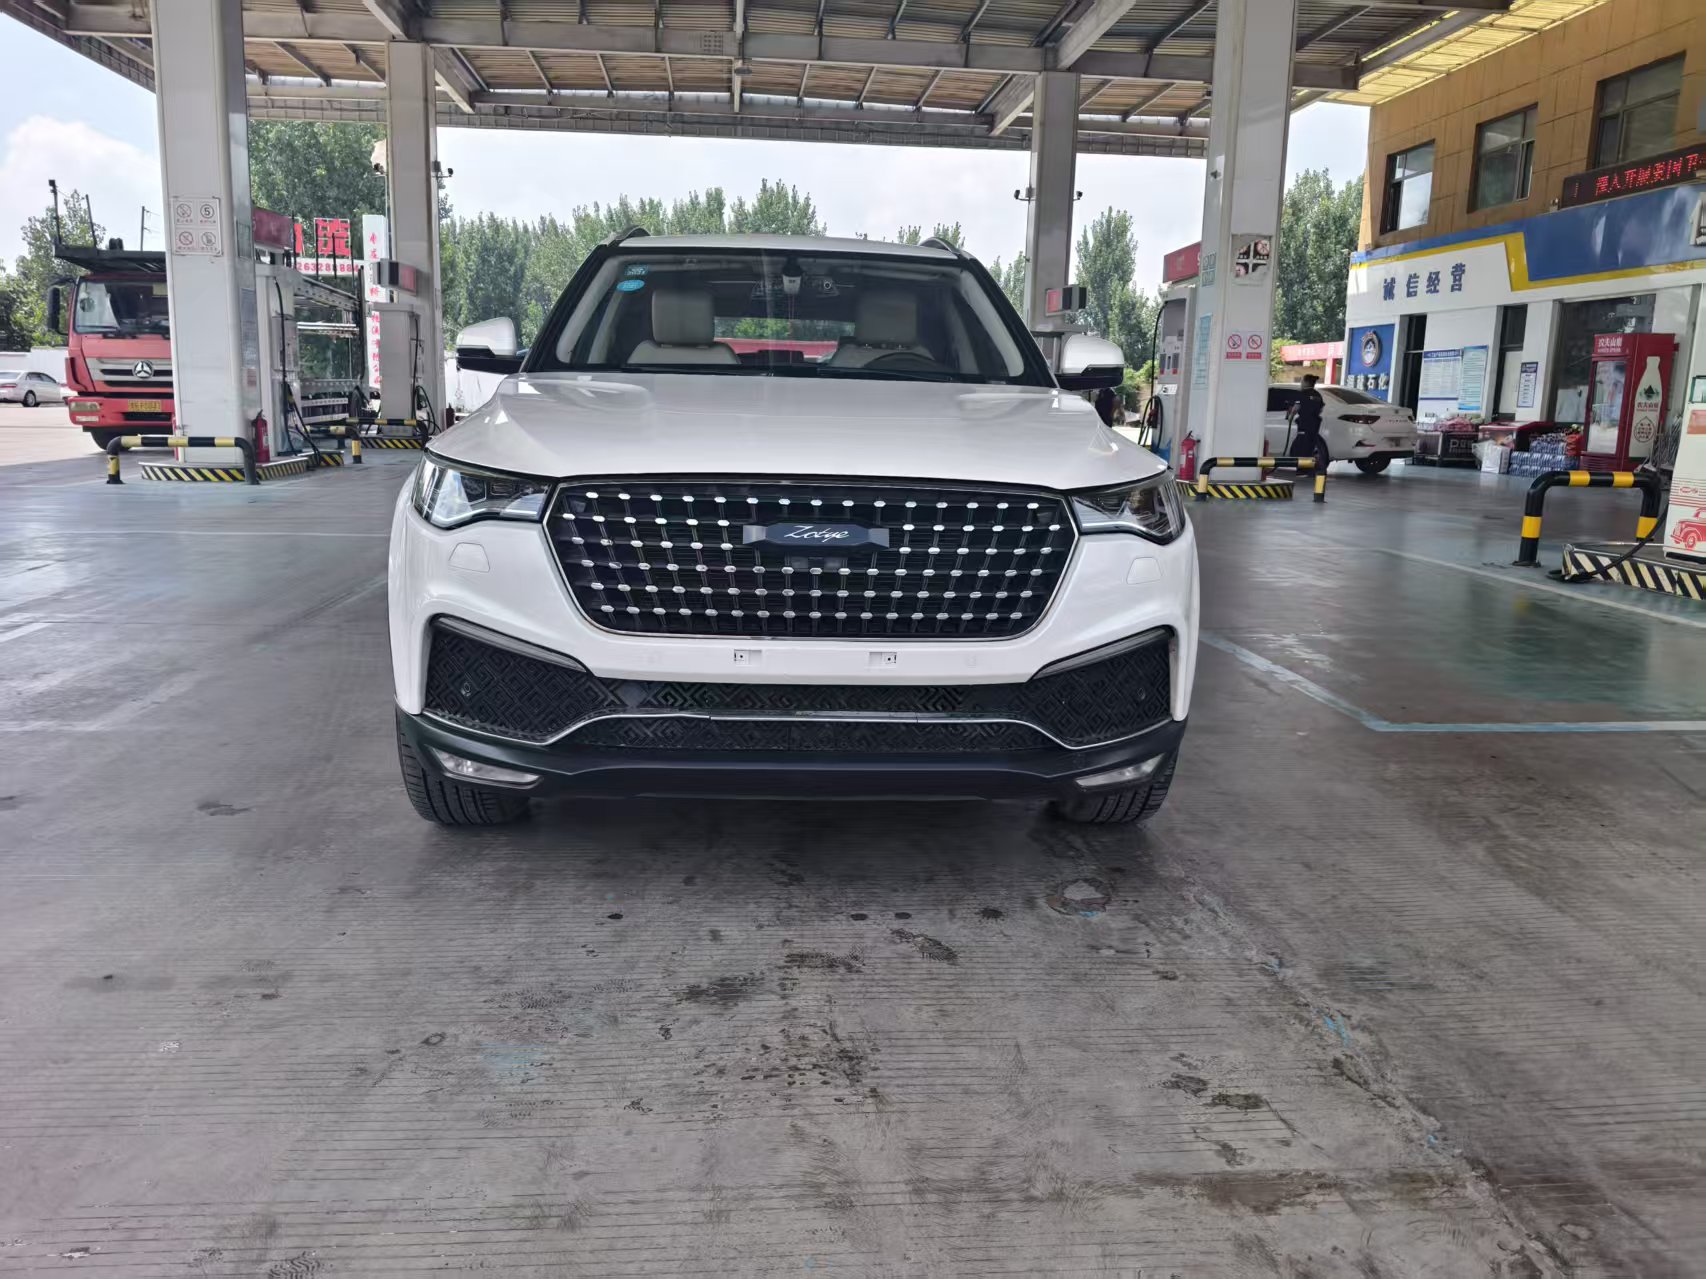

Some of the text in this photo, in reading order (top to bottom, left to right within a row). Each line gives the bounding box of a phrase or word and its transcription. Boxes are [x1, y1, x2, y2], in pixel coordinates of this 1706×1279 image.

[1383, 263, 1466, 301] 诚信经营
[784, 525, 850, 543] Zotye
